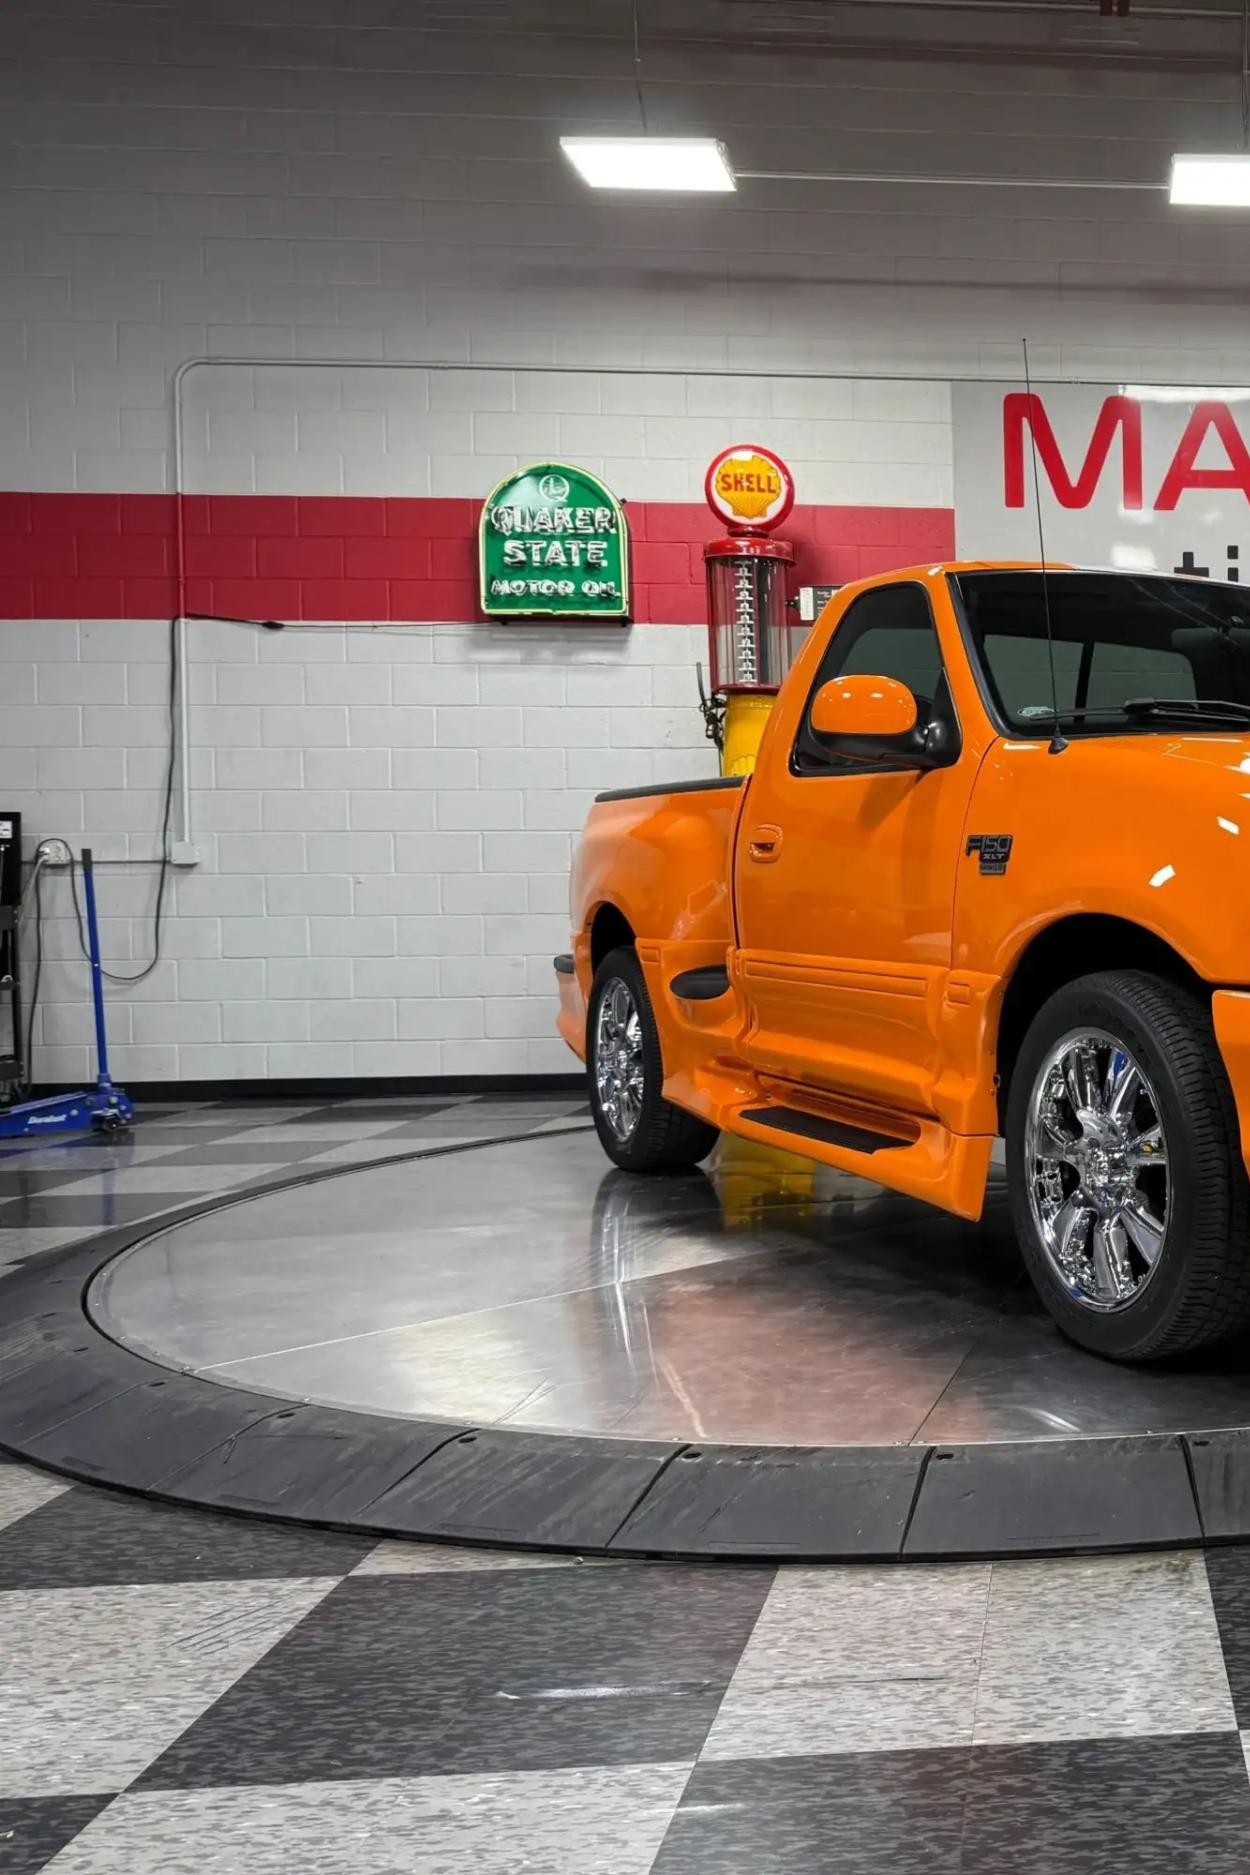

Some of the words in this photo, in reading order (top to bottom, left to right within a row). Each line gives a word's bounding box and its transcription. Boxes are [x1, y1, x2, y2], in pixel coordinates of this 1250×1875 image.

[720, 473, 777, 494] SHELL
[491, 506, 617, 535] QUAKER
[503, 540, 608, 567] STATE
[491, 579, 576, 597] MOTOR
[581, 580, 621, 597] OIL
